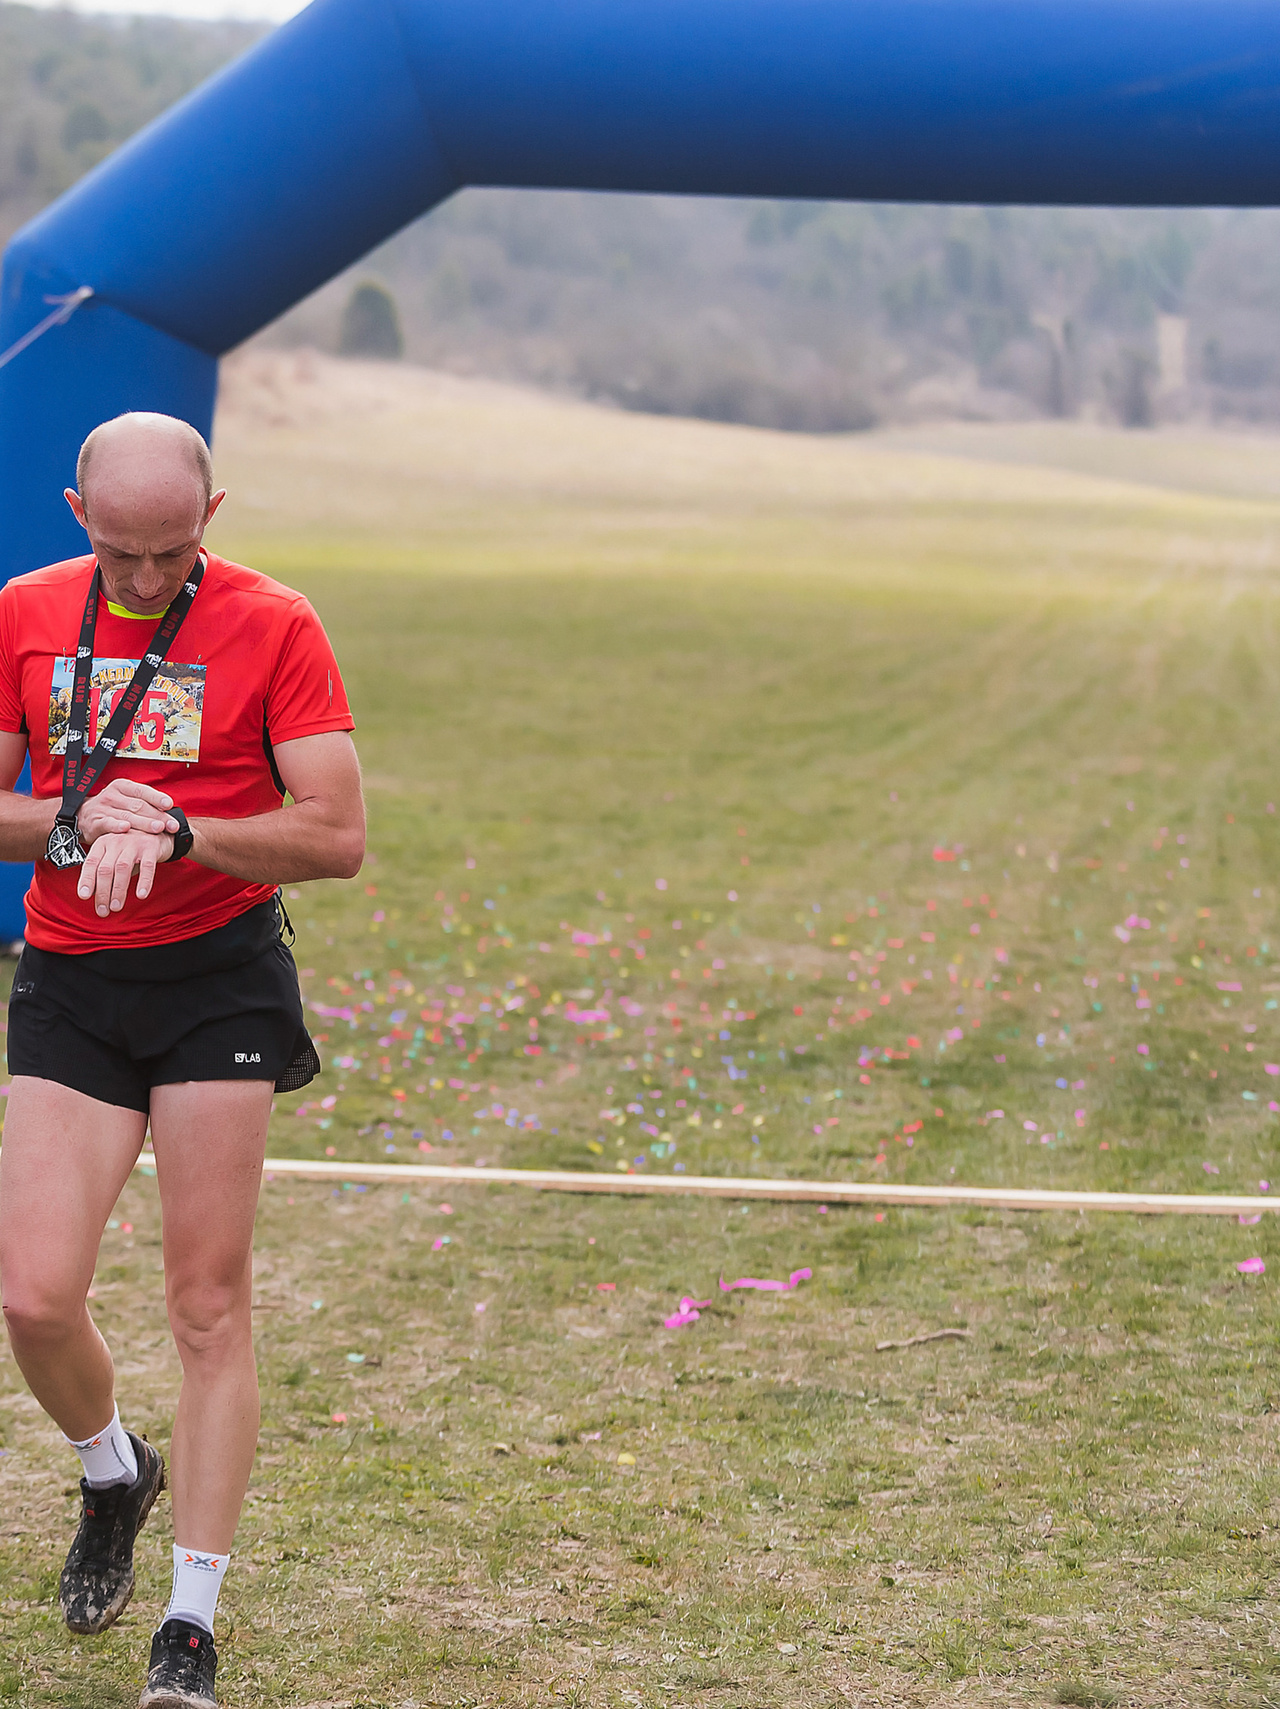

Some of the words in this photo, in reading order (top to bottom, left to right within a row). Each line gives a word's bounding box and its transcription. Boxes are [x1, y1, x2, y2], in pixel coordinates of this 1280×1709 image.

[85, 598, 95, 625] RUN
[160, 611, 180, 639] RUN
[75, 676, 86, 703] RUN
[122, 683, 143, 711] RUN
[155, 674, 190, 706] TRAIL
[66, 760, 77, 787] RUN
[76, 767, 97, 793] RUN
